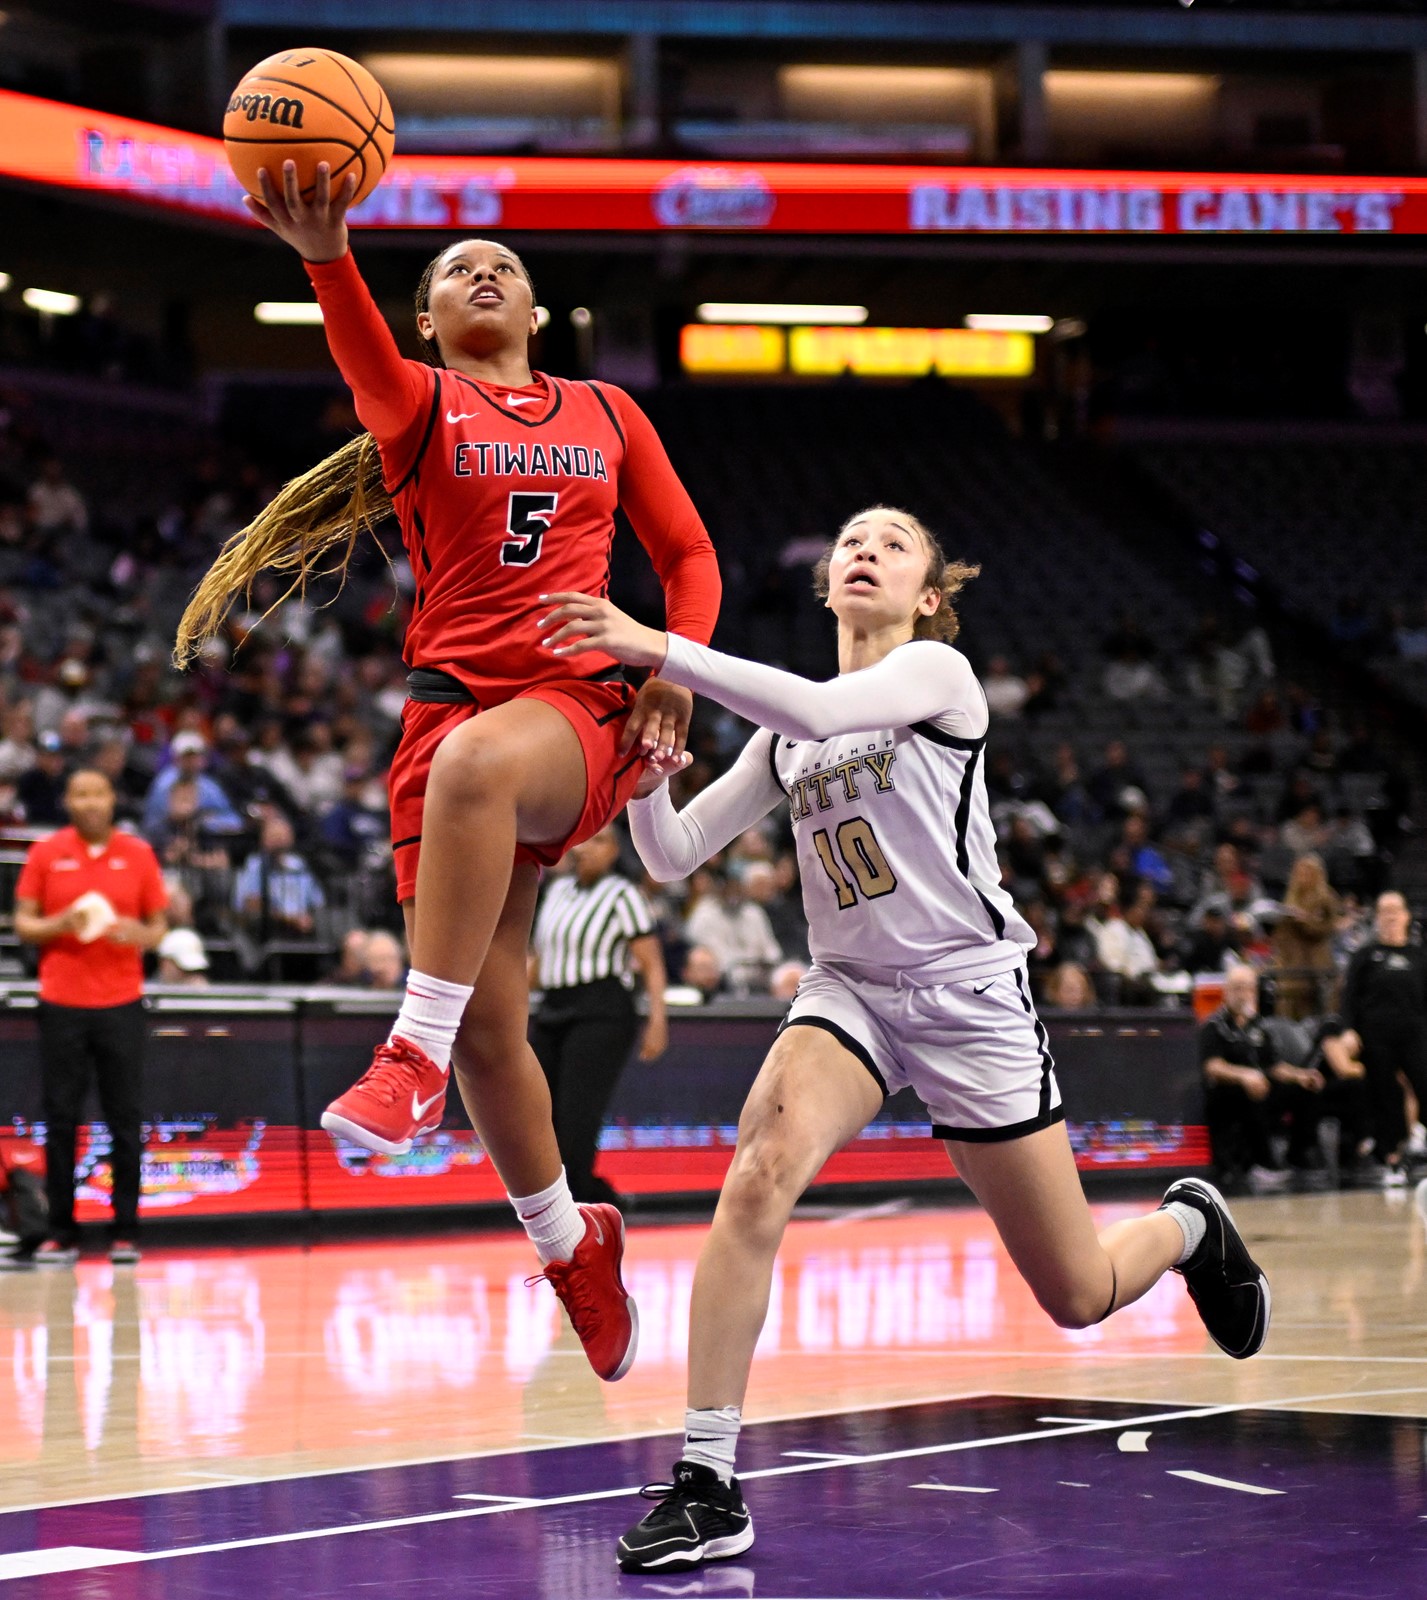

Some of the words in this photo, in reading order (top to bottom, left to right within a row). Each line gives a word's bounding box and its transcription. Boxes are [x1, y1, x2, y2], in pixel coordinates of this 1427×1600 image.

[909, 185, 1163, 231] RAISING
[454, 441, 609, 483] ETIWANDA
[499, 491, 559, 568] 5
[786, 740, 893, 783] HBISHOP
[812, 815, 898, 911] 10
